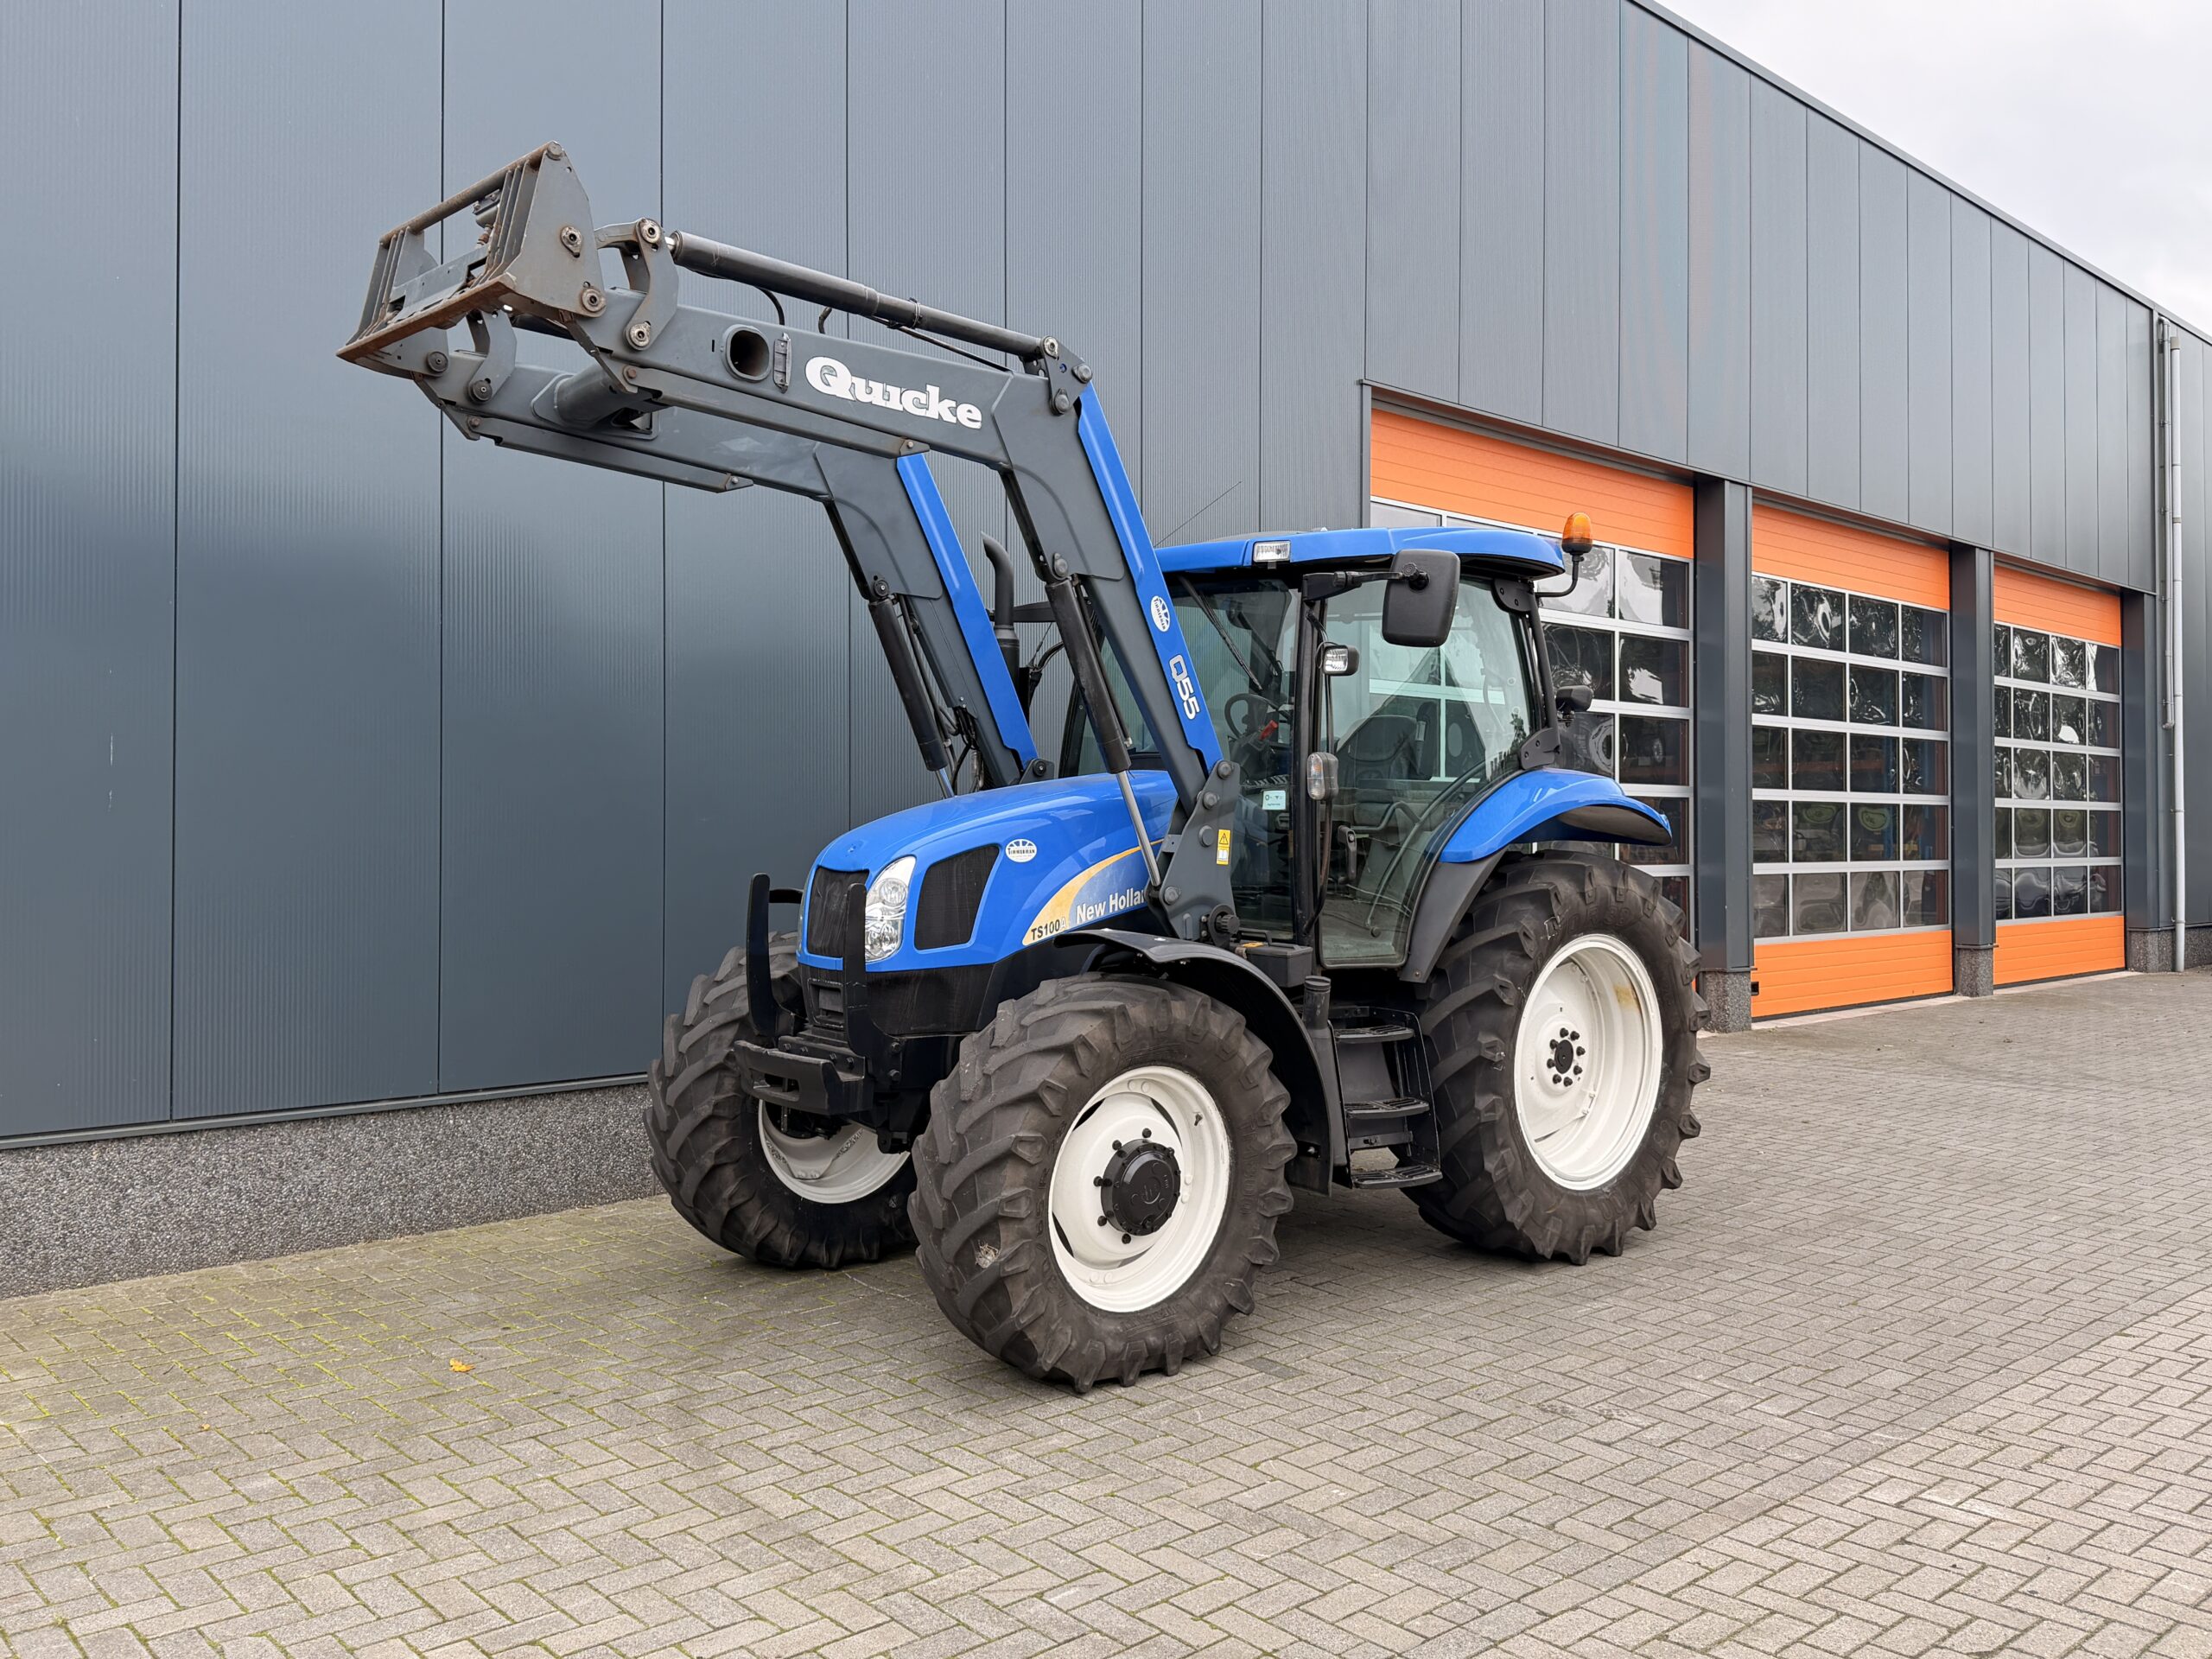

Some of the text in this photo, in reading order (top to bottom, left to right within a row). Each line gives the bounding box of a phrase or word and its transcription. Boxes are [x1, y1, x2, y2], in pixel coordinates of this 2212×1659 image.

[805, 356, 982, 429] Quicke
[1169, 654, 1200, 720] Q55
[1076, 887, 1144, 925] New Holla
